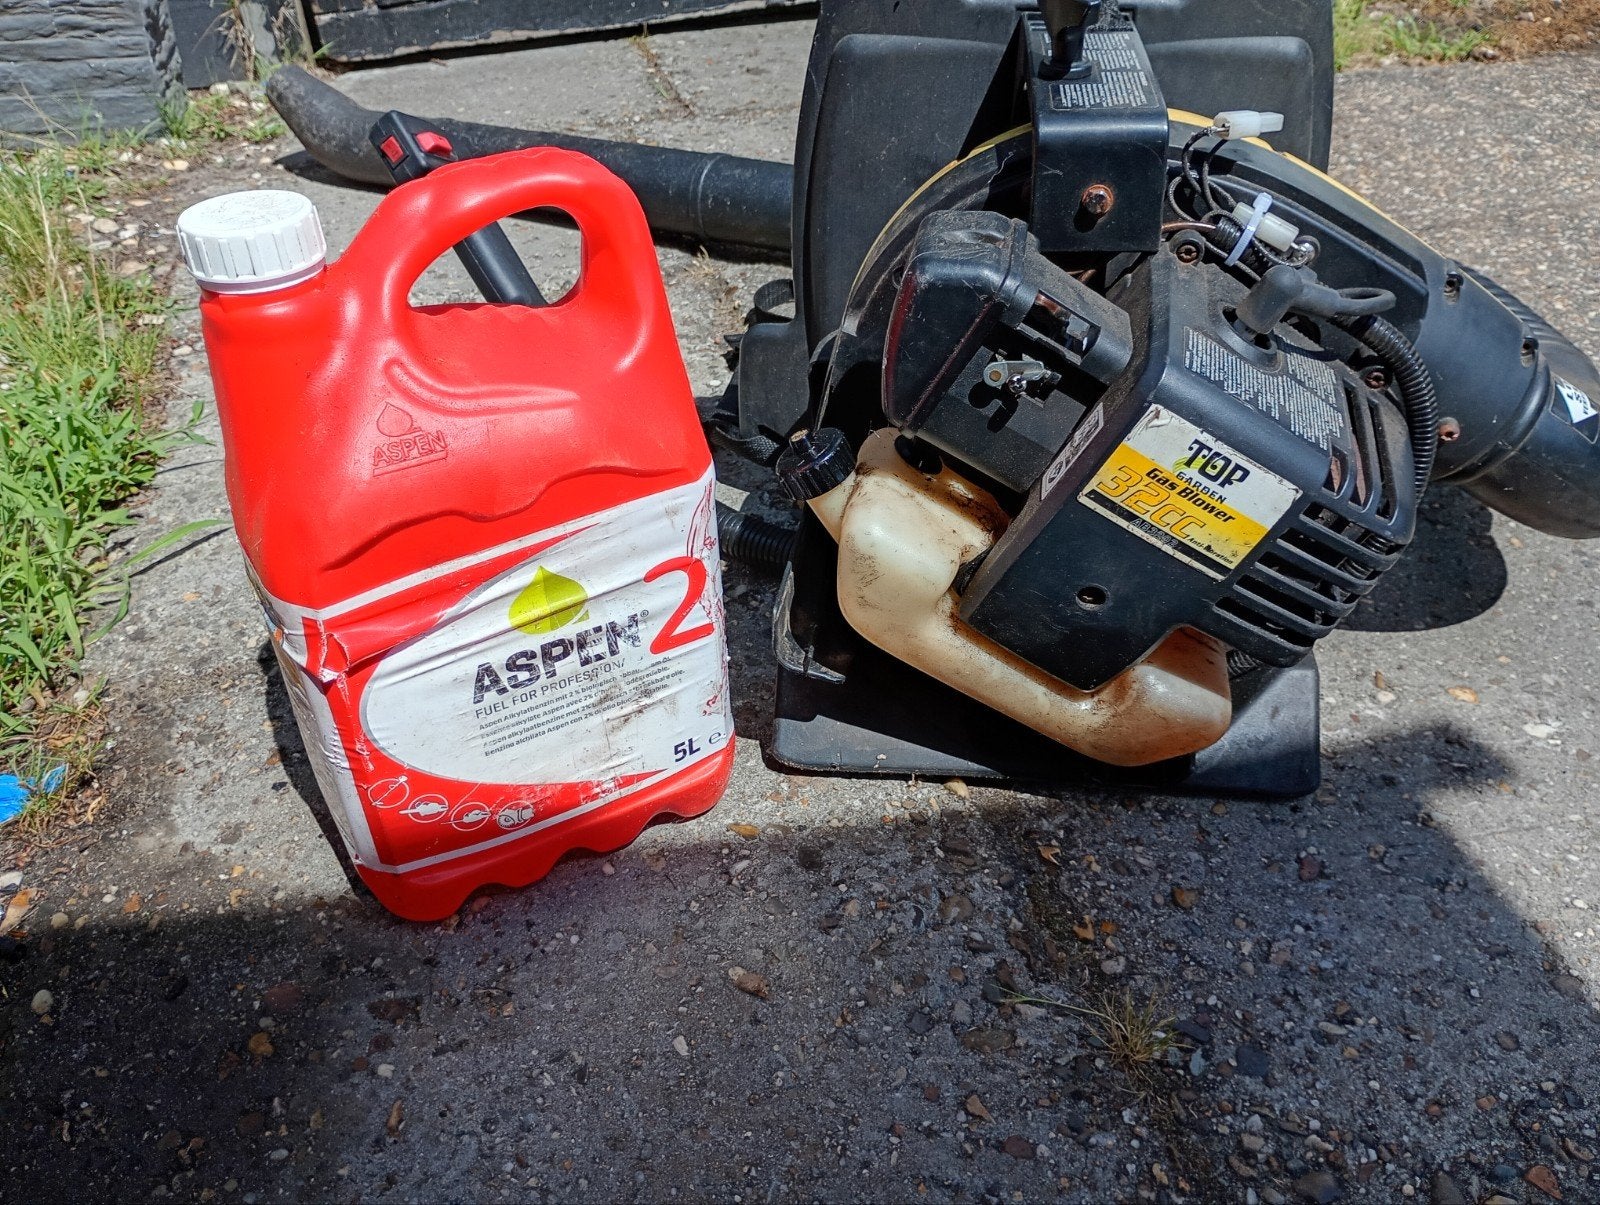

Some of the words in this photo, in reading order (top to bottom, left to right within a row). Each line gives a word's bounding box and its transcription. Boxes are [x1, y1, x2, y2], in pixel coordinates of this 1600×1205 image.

[372, 429, 448, 467] ASPEN
[1185, 438, 1251, 490] TOP
[1145, 467, 1182, 497] Gas
[1179, 486, 1237, 523] Blower
[1174, 471, 1228, 505] GARDEN
[643, 555, 715, 655] 2
[475, 701, 510, 719] FUEL
[511, 689, 538, 706] FOR
[673, 737, 701, 762] 5L
